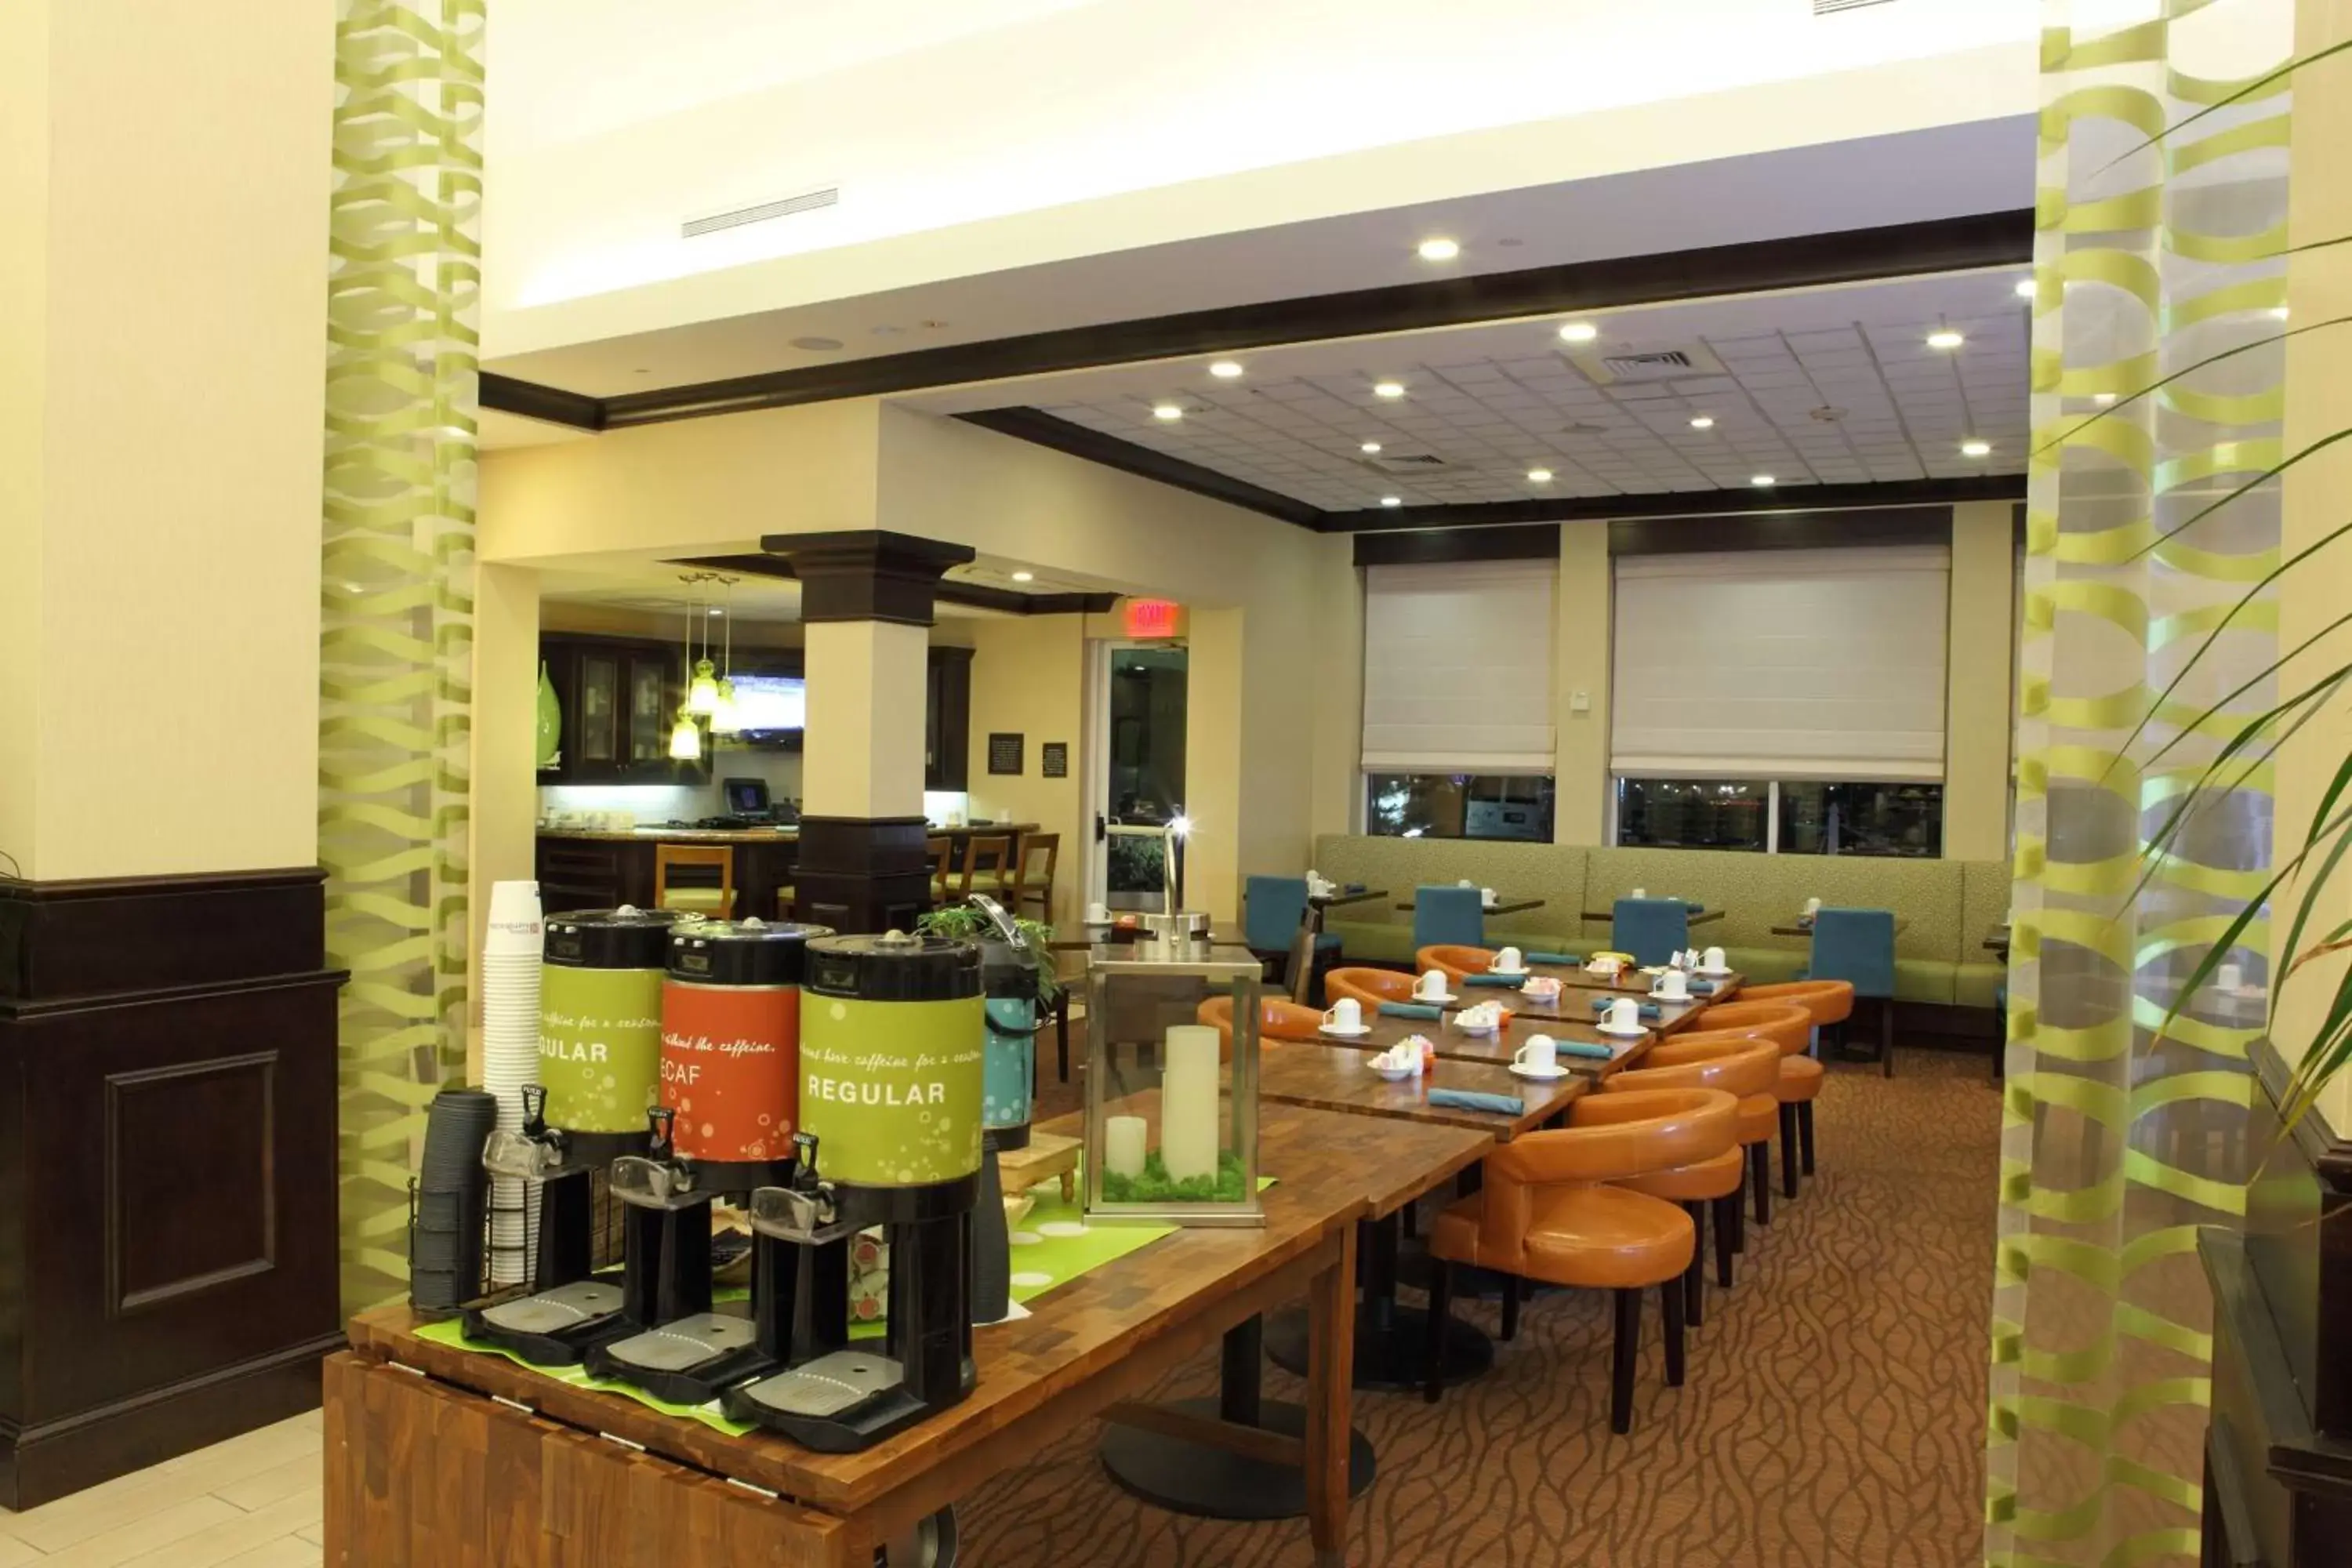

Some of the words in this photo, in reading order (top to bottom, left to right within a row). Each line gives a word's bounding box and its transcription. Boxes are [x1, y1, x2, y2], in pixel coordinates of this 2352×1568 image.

[539, 1035, 608, 1063] GULAR
[695, 1036, 714, 1052] the
[719, 1038, 776, 1058] caffeine.
[661, 1057, 701, 1086] ECAF
[855, 1053, 908, 1073] caffeine
[914, 1053, 936, 1073] for
[808, 1073, 946, 1106] REGULAR
